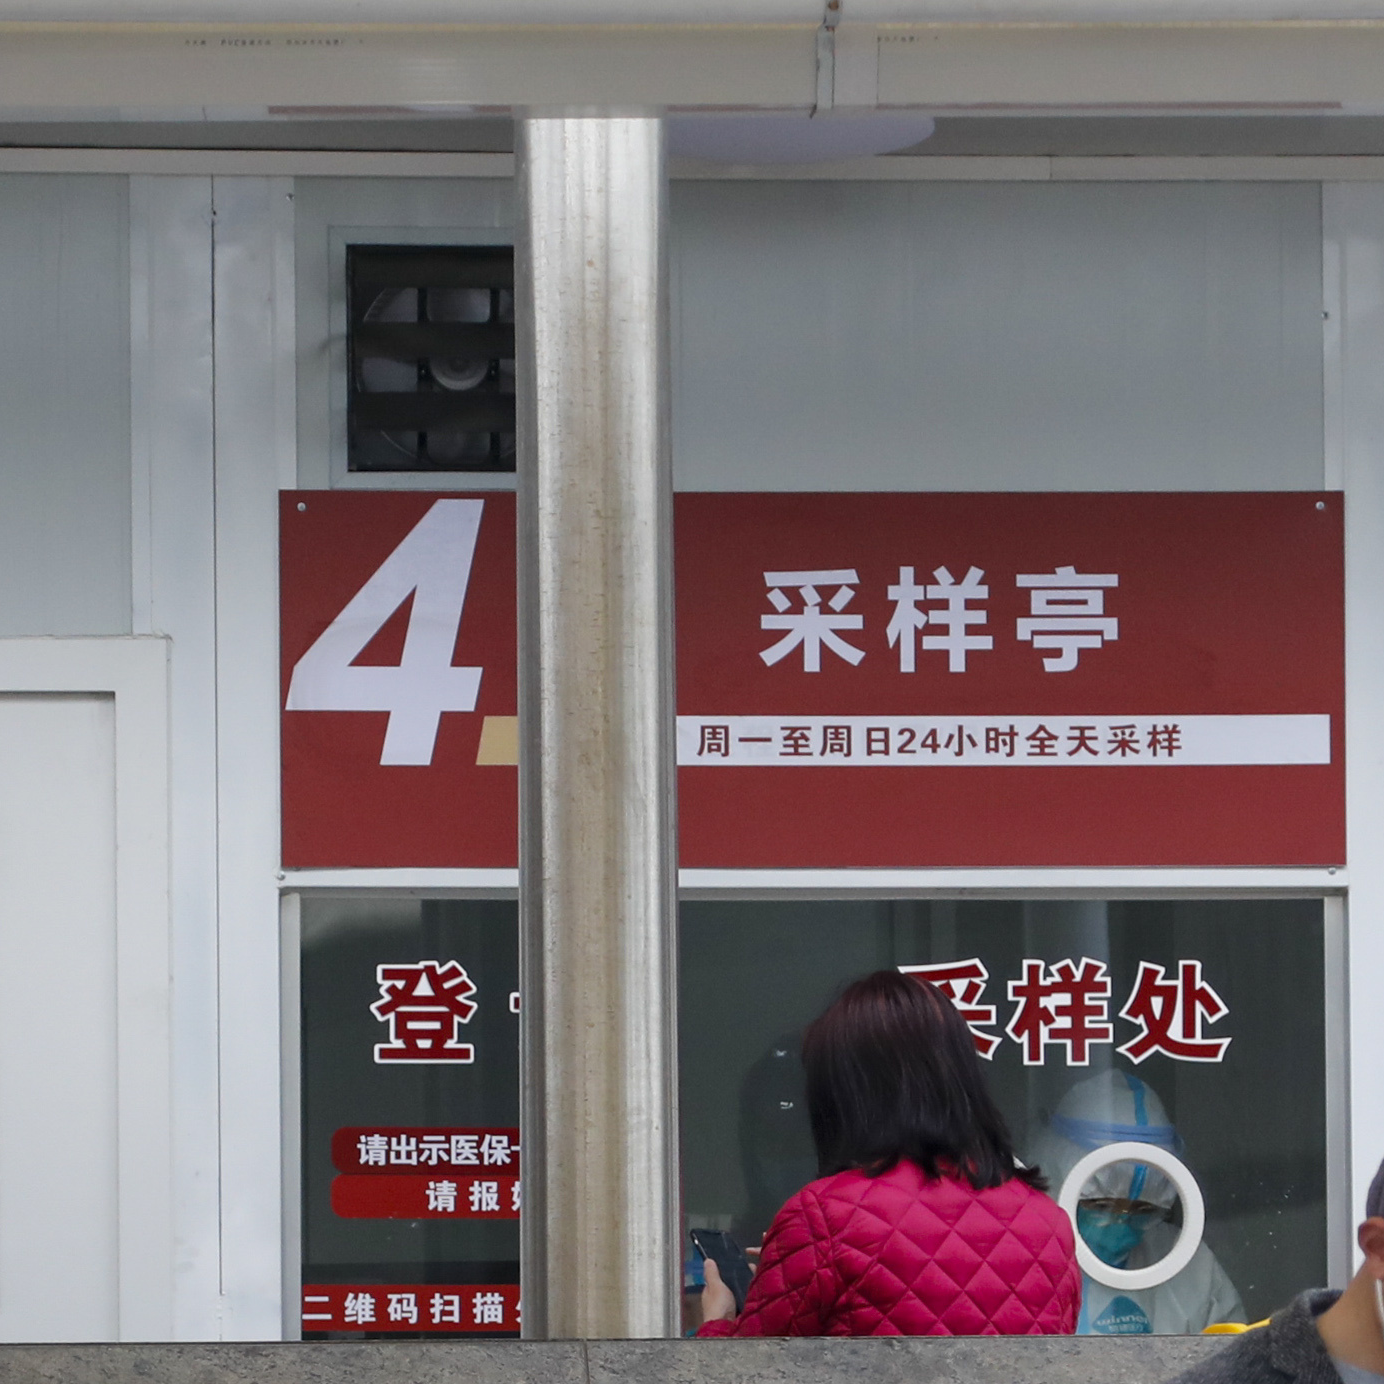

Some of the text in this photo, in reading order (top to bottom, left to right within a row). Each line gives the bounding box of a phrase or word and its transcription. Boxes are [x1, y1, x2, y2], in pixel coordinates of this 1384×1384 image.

[285, 498, 485, 766] 4
[759, 564, 1120, 673] 采样亭
[695, 723, 1183, 759] 周一至周日24小时全天采样
[370, 960, 520, 1063] 登
[356, 1133, 520, 1166] 请出示医保
[301, 1291, 520, 1325] 二维码扫描
